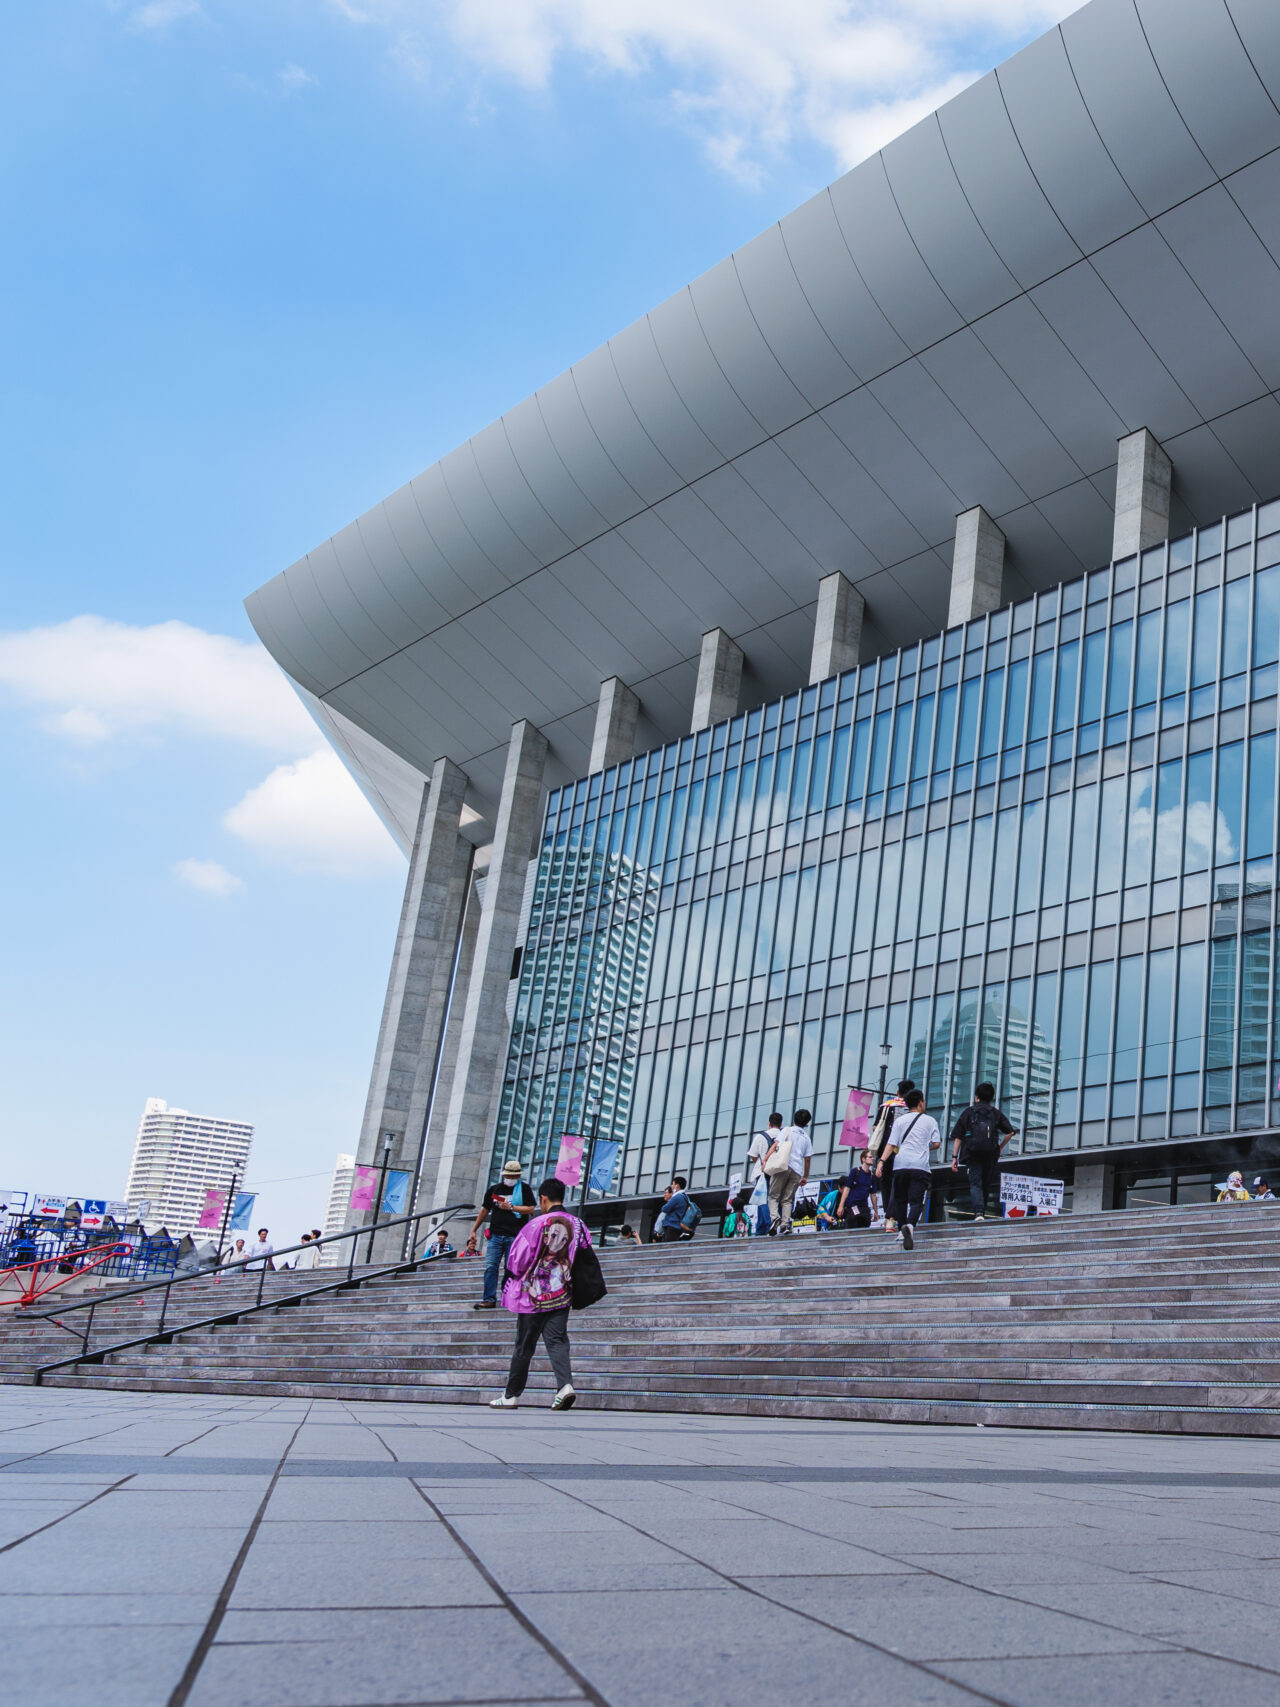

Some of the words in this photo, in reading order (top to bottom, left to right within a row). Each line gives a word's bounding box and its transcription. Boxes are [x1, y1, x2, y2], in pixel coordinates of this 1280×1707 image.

[1001, 1192, 1032, 1202] 専用入場口
[1039, 1198, 1057, 1206] 入場口
